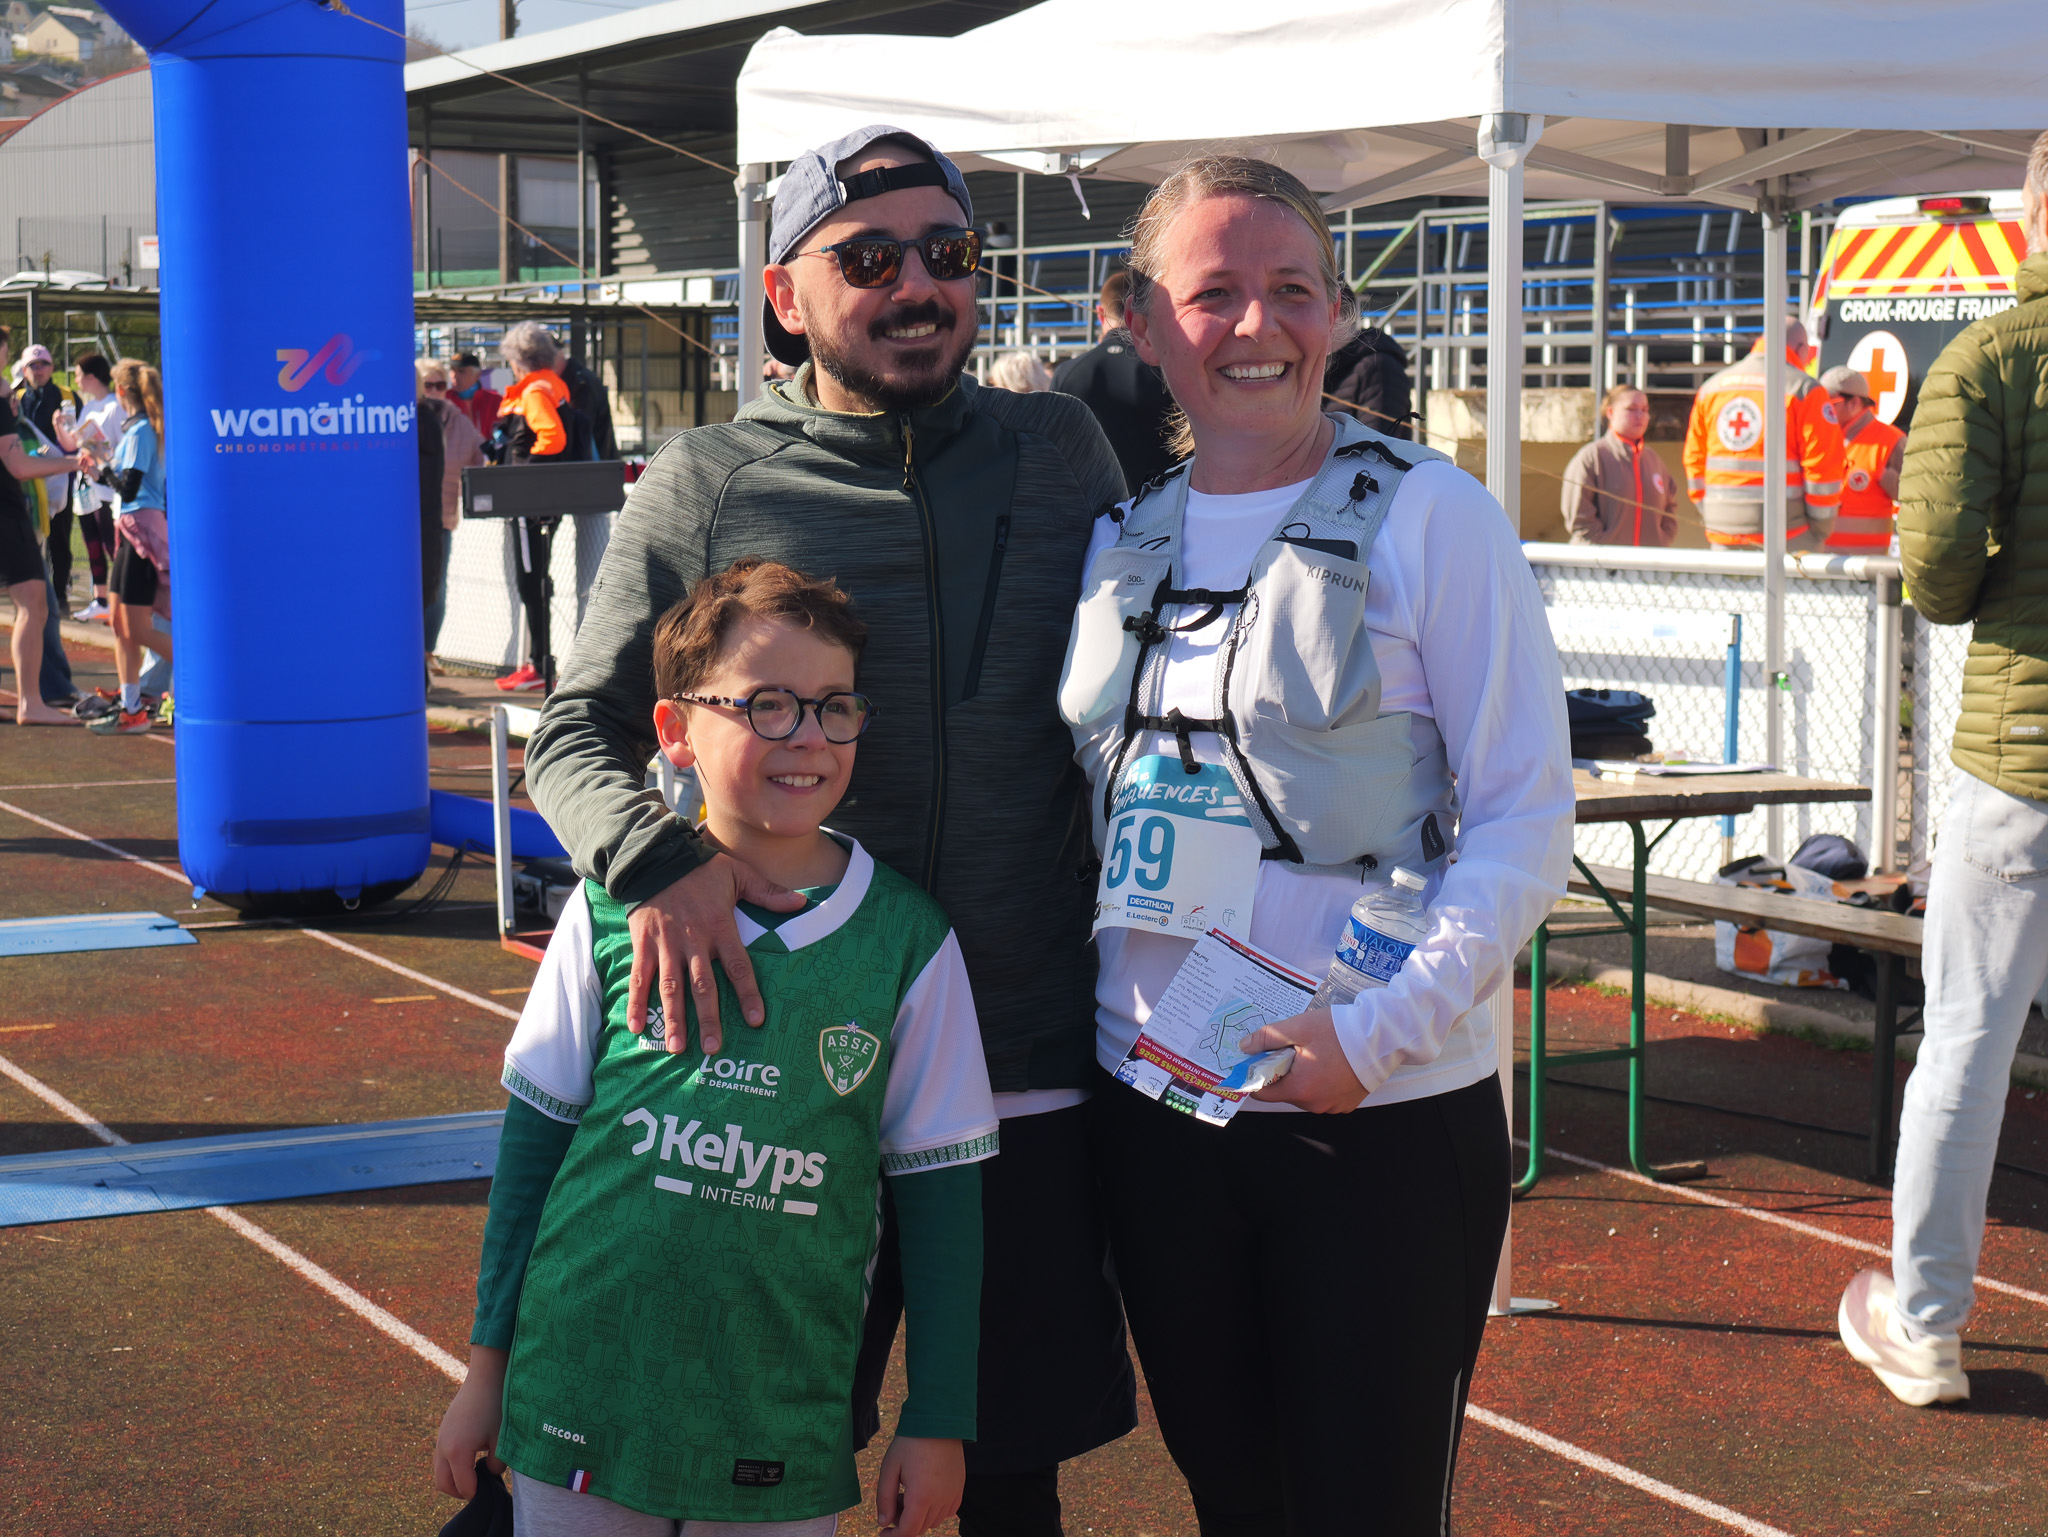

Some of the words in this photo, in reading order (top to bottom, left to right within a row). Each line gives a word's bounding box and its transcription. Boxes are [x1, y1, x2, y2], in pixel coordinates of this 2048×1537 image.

[1840, 299, 1954, 322] CROIX-ROUGE
[1307, 565, 1364, 593] KIPRUN
[1106, 815, 1175, 891] 59
[1130, 896, 1171, 911] DECATHLON
[1126, 911, 1158, 923] E.Leclerc
[638, 1036, 668, 1051] humm
[828, 1034, 872, 1055] ASSE
[1139, 1037, 1152, 1047] vert
[1151, 1044, 1172, 1060] Chemin
[1138, 1047, 1160, 1063] 2026
[700, 1055, 780, 1086] Loire
[1160, 1059, 1184, 1076] MARS
[1200, 1070, 1223, 1084] ymnase
[695, 1076, 706, 1084] LE
[709, 1079, 777, 1098] DÉPARTEMENT
[660, 1114, 827, 1194] Kelyps
[700, 1184, 776, 1212] INTERIM
[543, 1423, 586, 1445] BEECOOL
